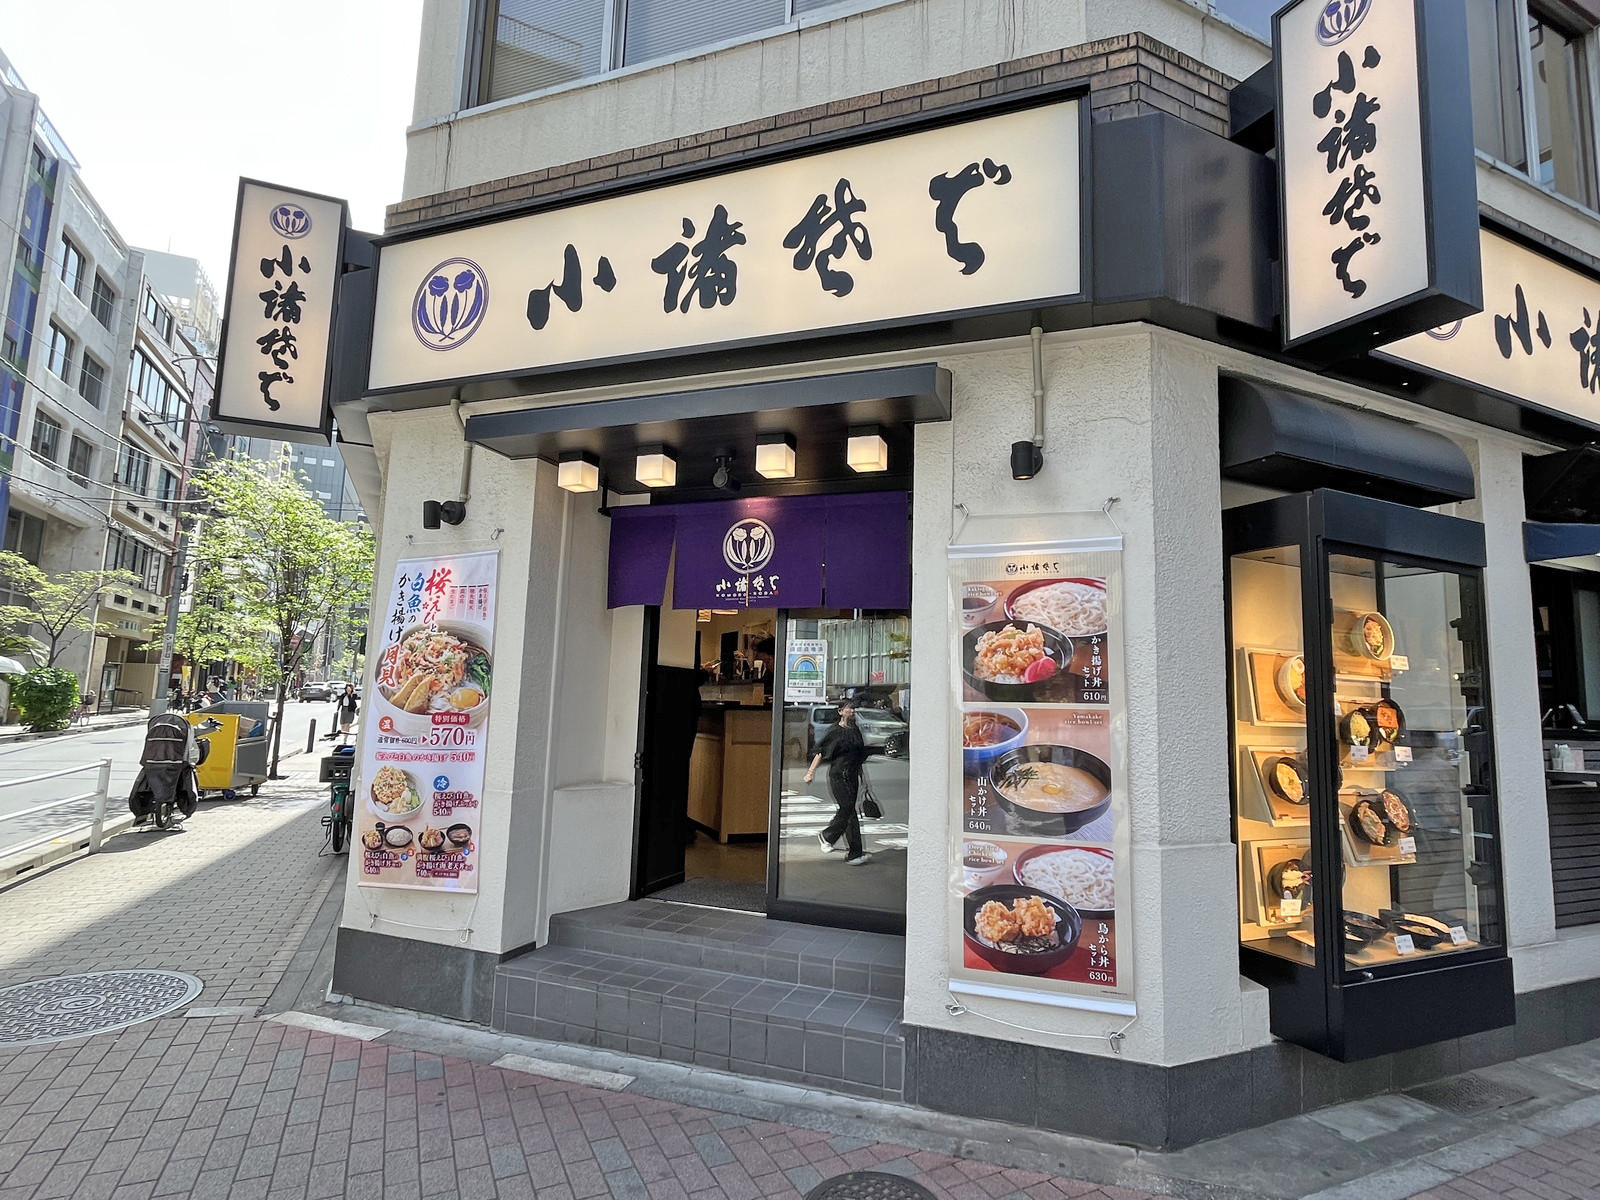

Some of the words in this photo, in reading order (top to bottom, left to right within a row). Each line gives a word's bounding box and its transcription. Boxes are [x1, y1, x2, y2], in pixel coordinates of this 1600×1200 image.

[407, 572, 426, 624] 白魚の
[1090, 635, 1102, 688] かき揚げ丼
[1082, 666, 1090, 688] セット
[1083, 691, 1107, 701] 610円
[434, 715, 466, 723] 特別価格
[969, 796, 977, 816] セット
[977, 776, 988, 817] 山かけ丼
[969, 821, 991, 831] 640円
[1088, 944, 1097, 966] セット
[1089, 971, 1114, 983] 630円
